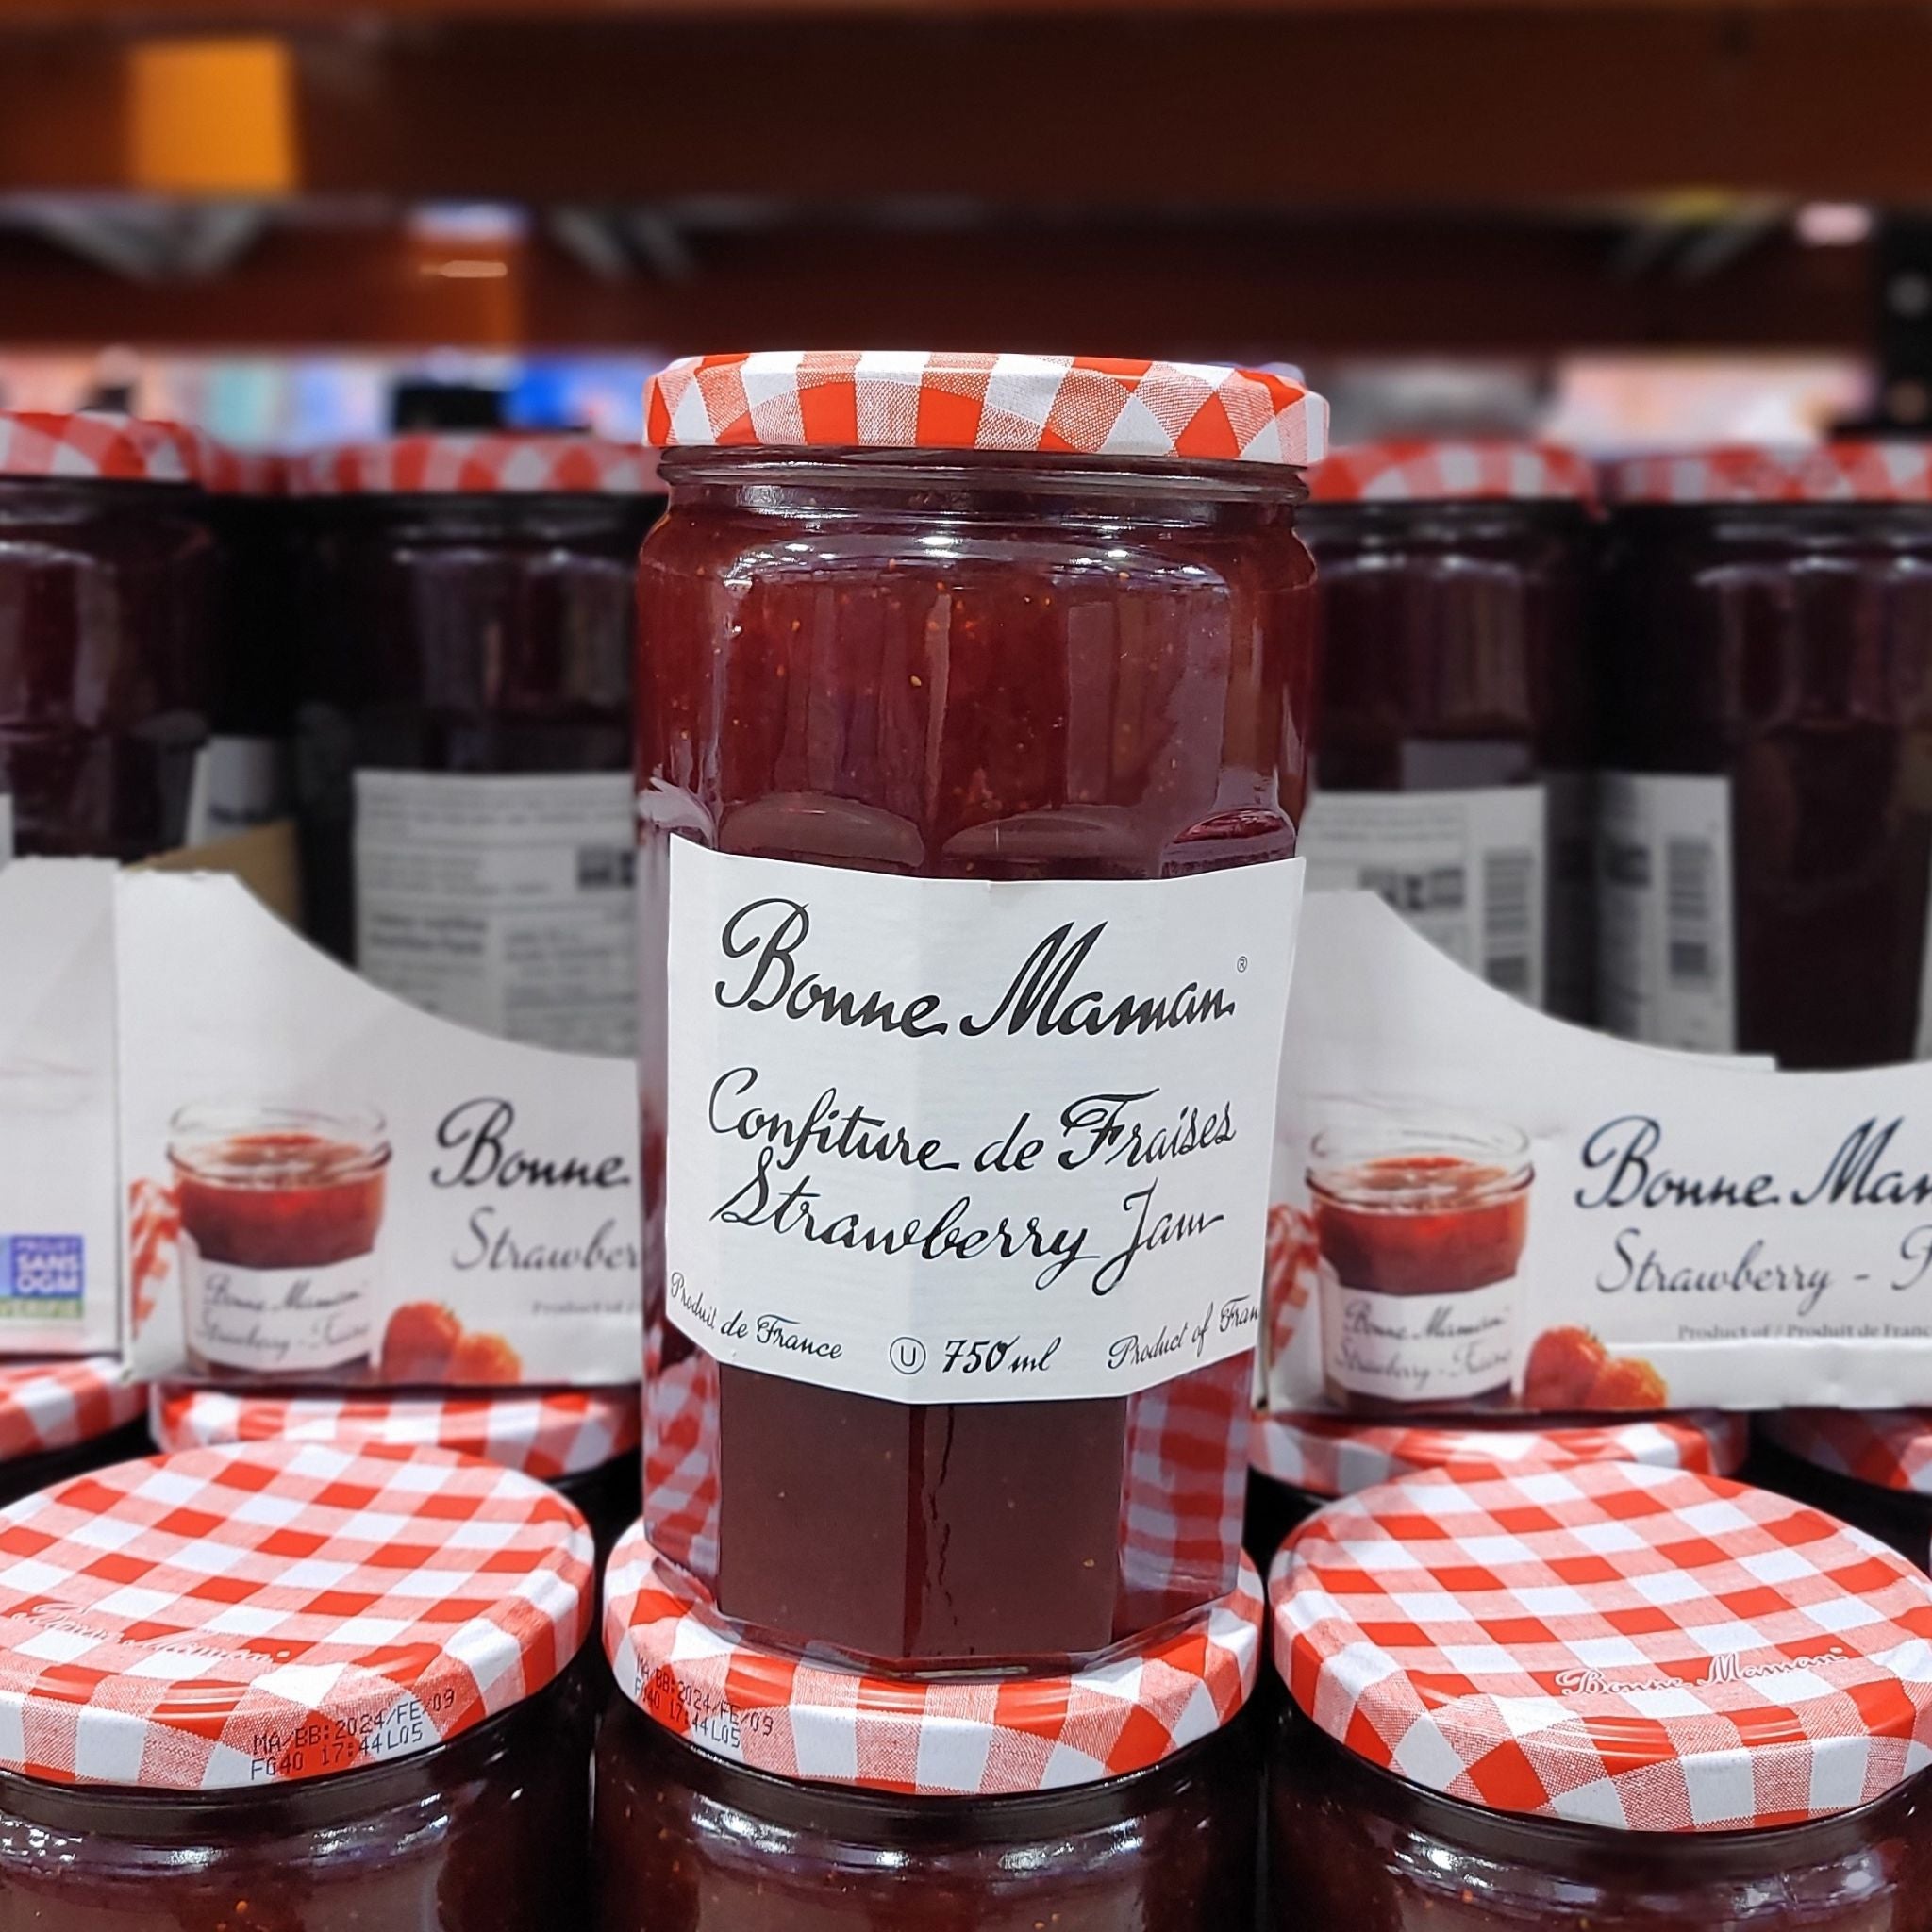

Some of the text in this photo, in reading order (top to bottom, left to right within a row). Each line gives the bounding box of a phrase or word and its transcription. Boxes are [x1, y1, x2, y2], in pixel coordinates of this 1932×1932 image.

[714, 897, 949, 1037] Bonne
[430, 1096, 631, 1189] Bonne
[708, 1067, 1236, 1173] Confiture de Fraises
[1574, 1114, 1780, 1209] Bonne
[710, 1146, 1224, 1296] Strawberry Jam
[671, 1272, 843, 1359] Produit de France
[1596, 1226, 1831, 1317] Strawberry
[1107, 1323, 1188, 1370] Product
[1191, 1302, 1214, 1358] of
[1556, 1666, 1695, 1697] Bonne
